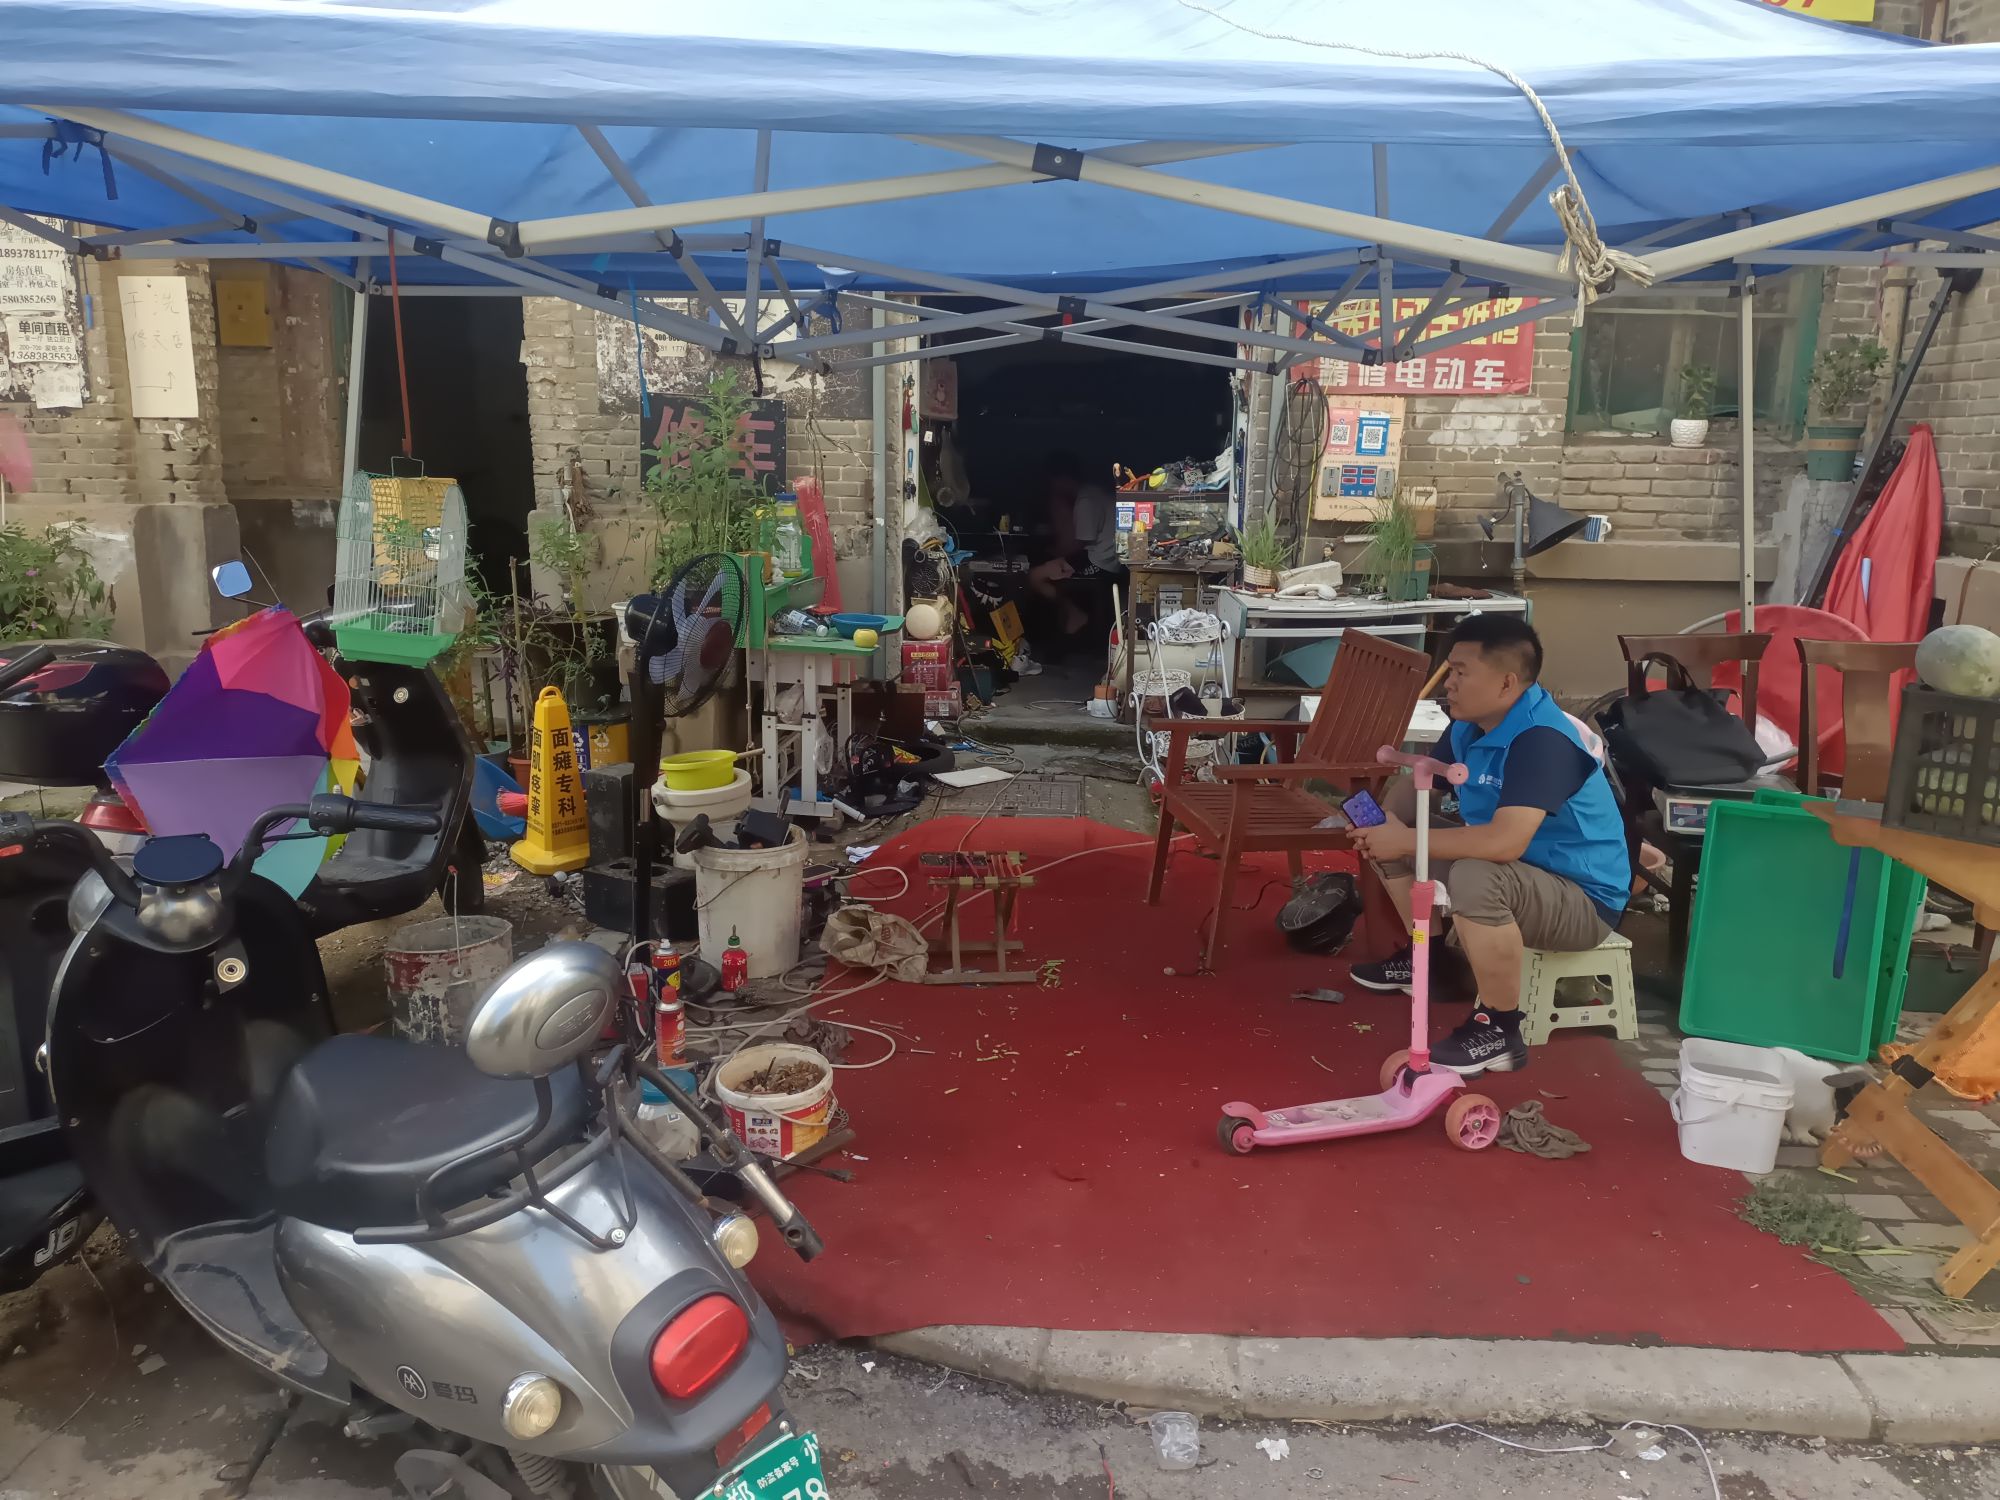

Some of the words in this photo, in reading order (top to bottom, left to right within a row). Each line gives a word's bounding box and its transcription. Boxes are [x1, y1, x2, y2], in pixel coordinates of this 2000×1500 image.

[0, 248, 63, 259] 1893781177
[19, 320, 70, 336] 单间直租
[11, 351, 77, 361] 13683835534
[1319, 357, 1505, 391] 精修电动车
[551, 727, 576, 817] 面瘫专科
[1385, 970, 1413, 980] PEP
[1468, 1038, 1506, 1060] PEPSI
[756, 1456, 800, 1490] 防盗备案号
